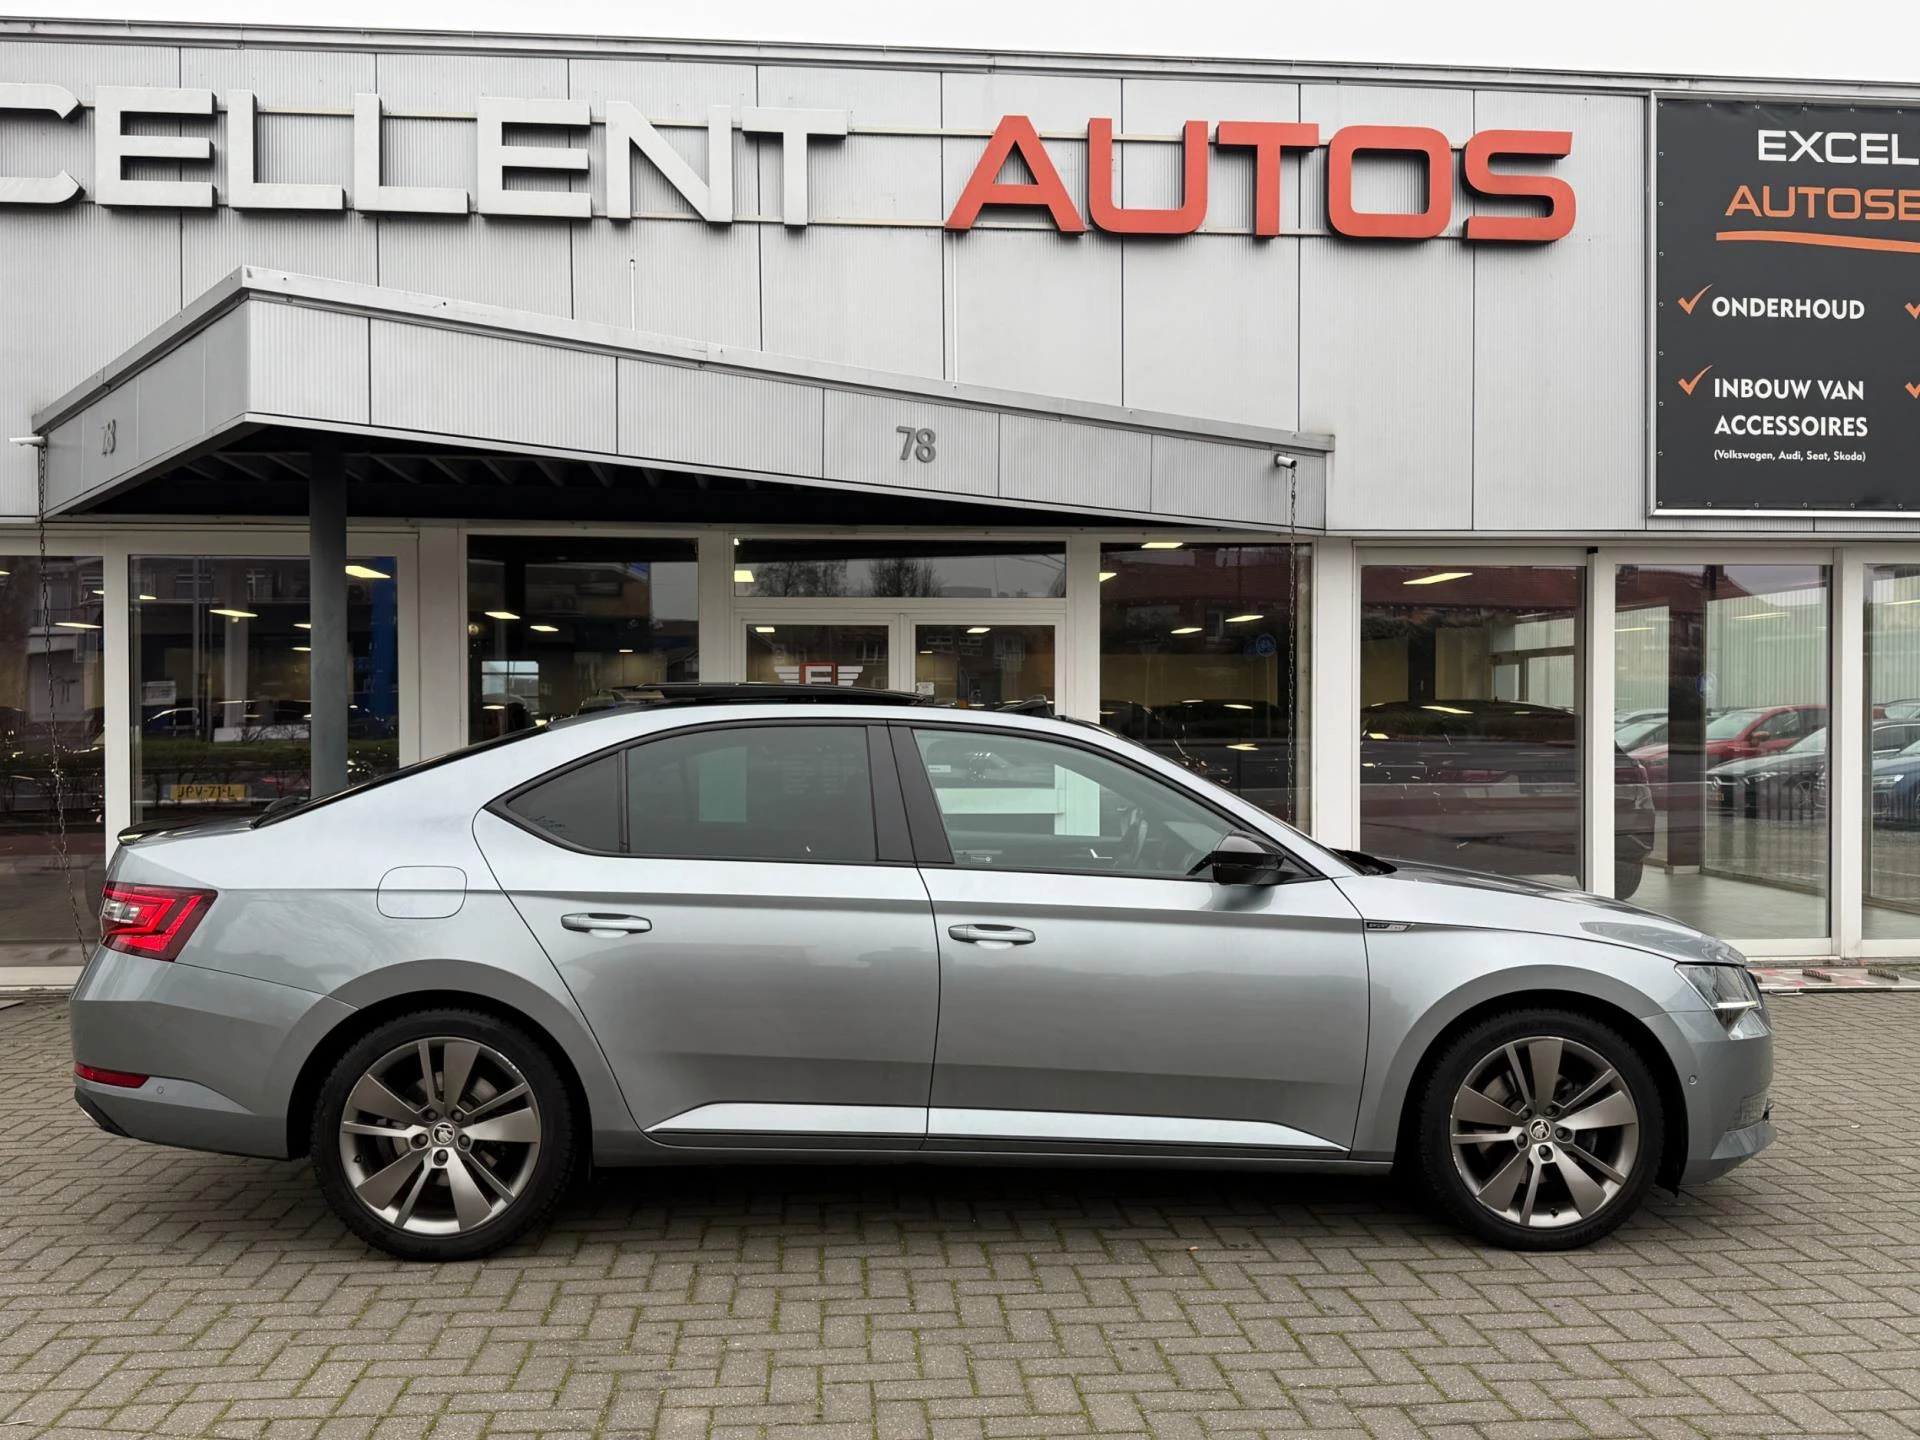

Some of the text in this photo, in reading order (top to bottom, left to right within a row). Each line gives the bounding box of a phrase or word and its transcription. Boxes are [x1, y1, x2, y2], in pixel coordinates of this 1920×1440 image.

[1757, 129, 1920, 166] EXCEL
[944, 114, 1577, 242] AUTOS
[1711, 296, 1865, 320] ONDERHOUD
[1714, 377, 1864, 401] INBOUW VAN
[1714, 414, 1868, 437] ACCESSOIRES
[896, 425, 936, 463] 78
[1714, 449, 1867, 463] (Volkswagen, Audi, Seat, Skoda)
